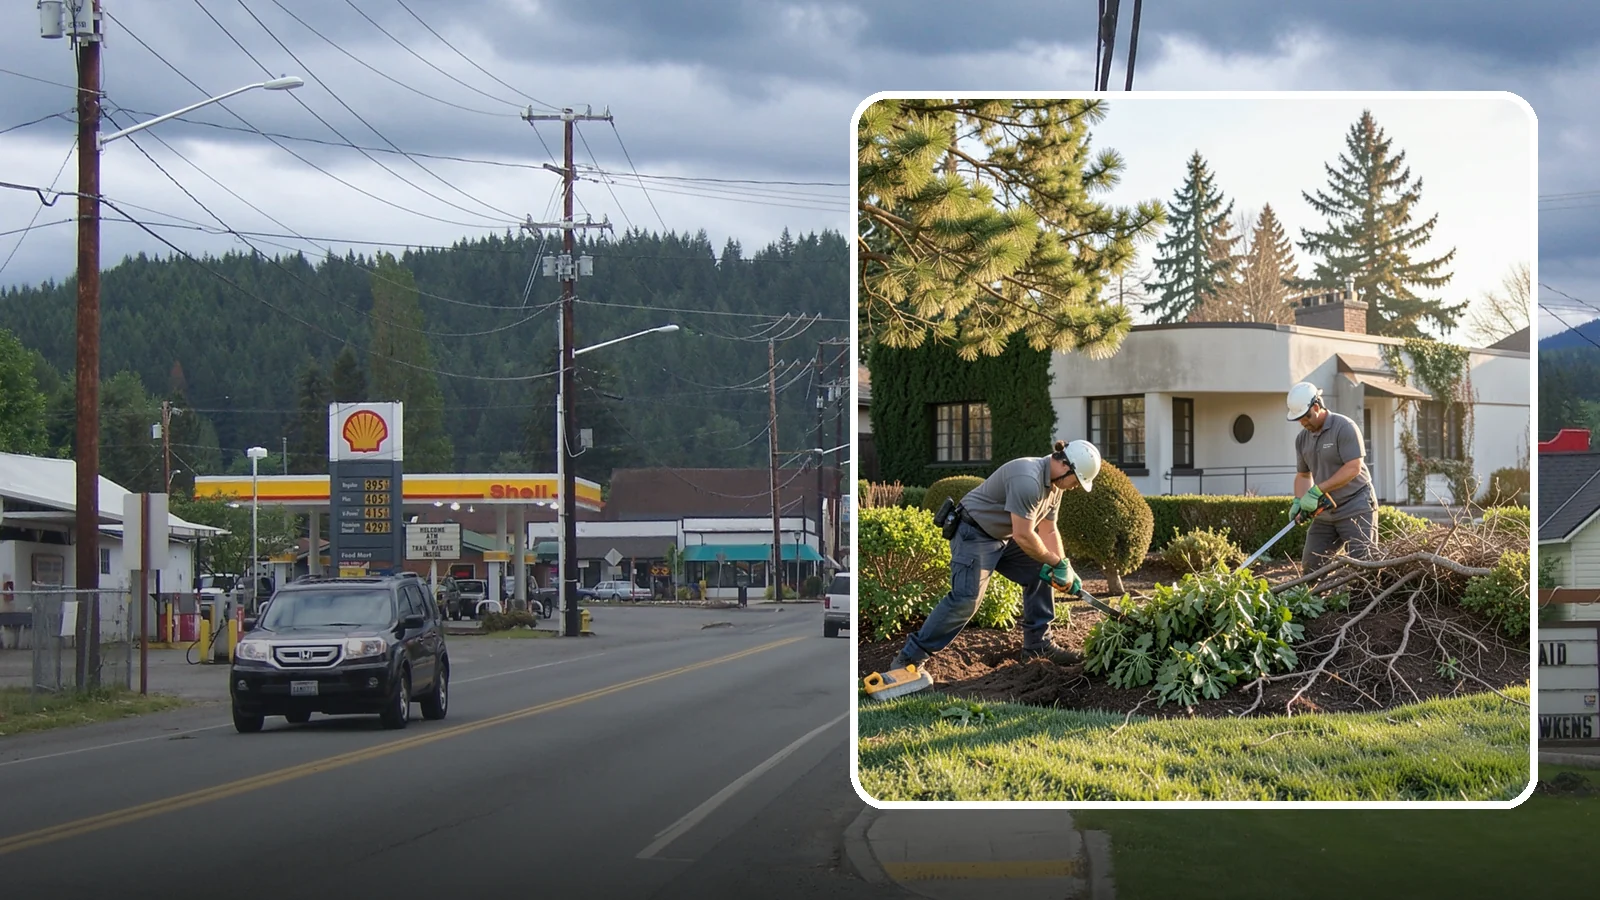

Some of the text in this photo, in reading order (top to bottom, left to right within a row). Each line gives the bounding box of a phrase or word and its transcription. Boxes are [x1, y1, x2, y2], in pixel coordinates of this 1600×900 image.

[366, 480, 383, 490] 395
[490, 484, 547, 499] Shell
[366, 494, 383, 504] 405
[366, 508, 383, 518] 415
[366, 522, 383, 532] 429
